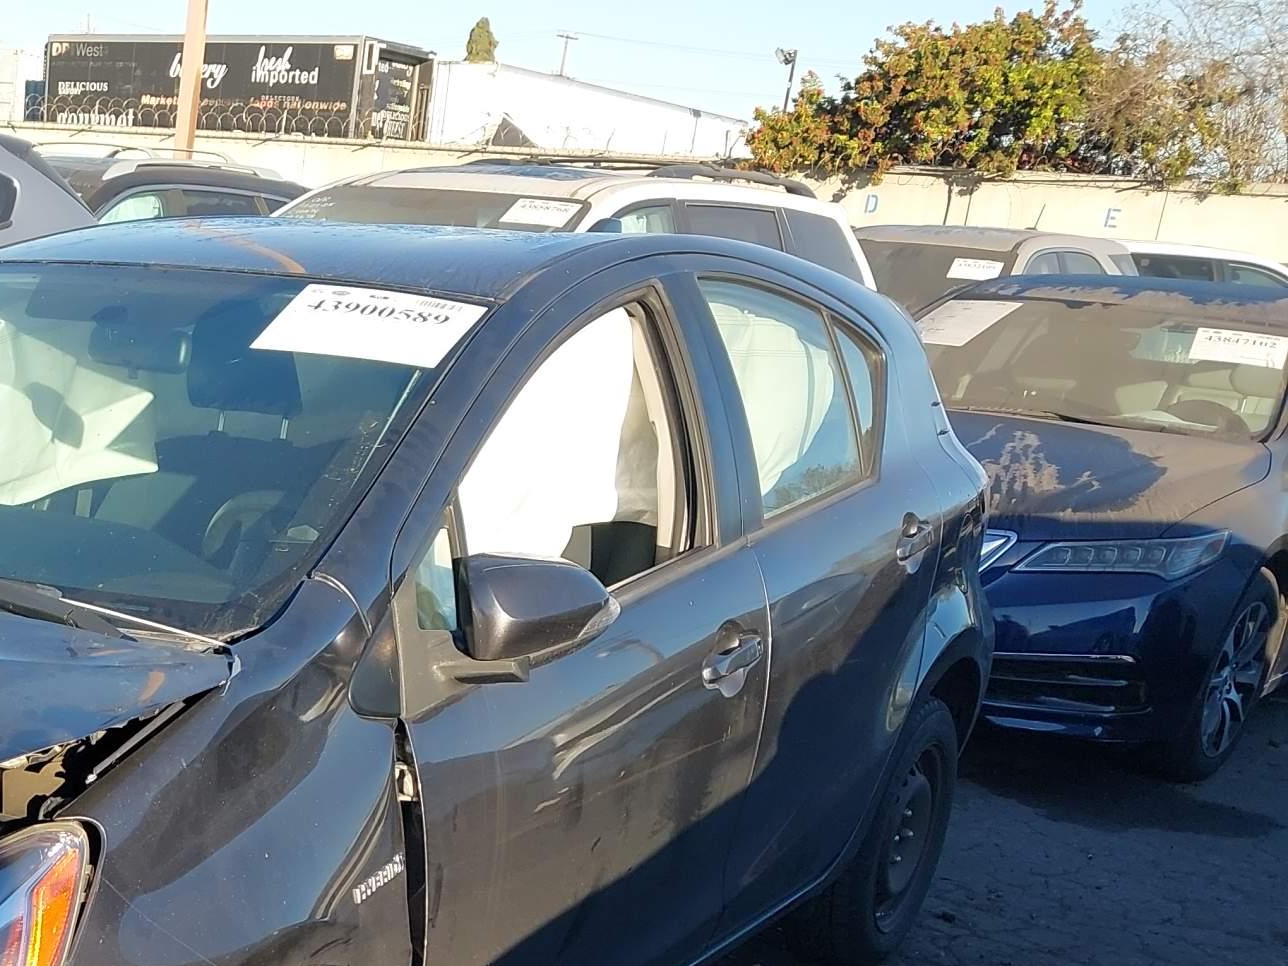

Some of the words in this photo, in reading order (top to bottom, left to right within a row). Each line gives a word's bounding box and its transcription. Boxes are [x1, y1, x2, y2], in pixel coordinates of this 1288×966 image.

[76, 42, 104, 57] West
[169, 52, 228, 89] bery
[251, 66, 319, 87] imported
[58, 81, 109, 92] DELICIOUS
[864, 194, 879, 214] D
[1103, 208, 1122, 229] E
[307, 299, 450, 325] 43900589
